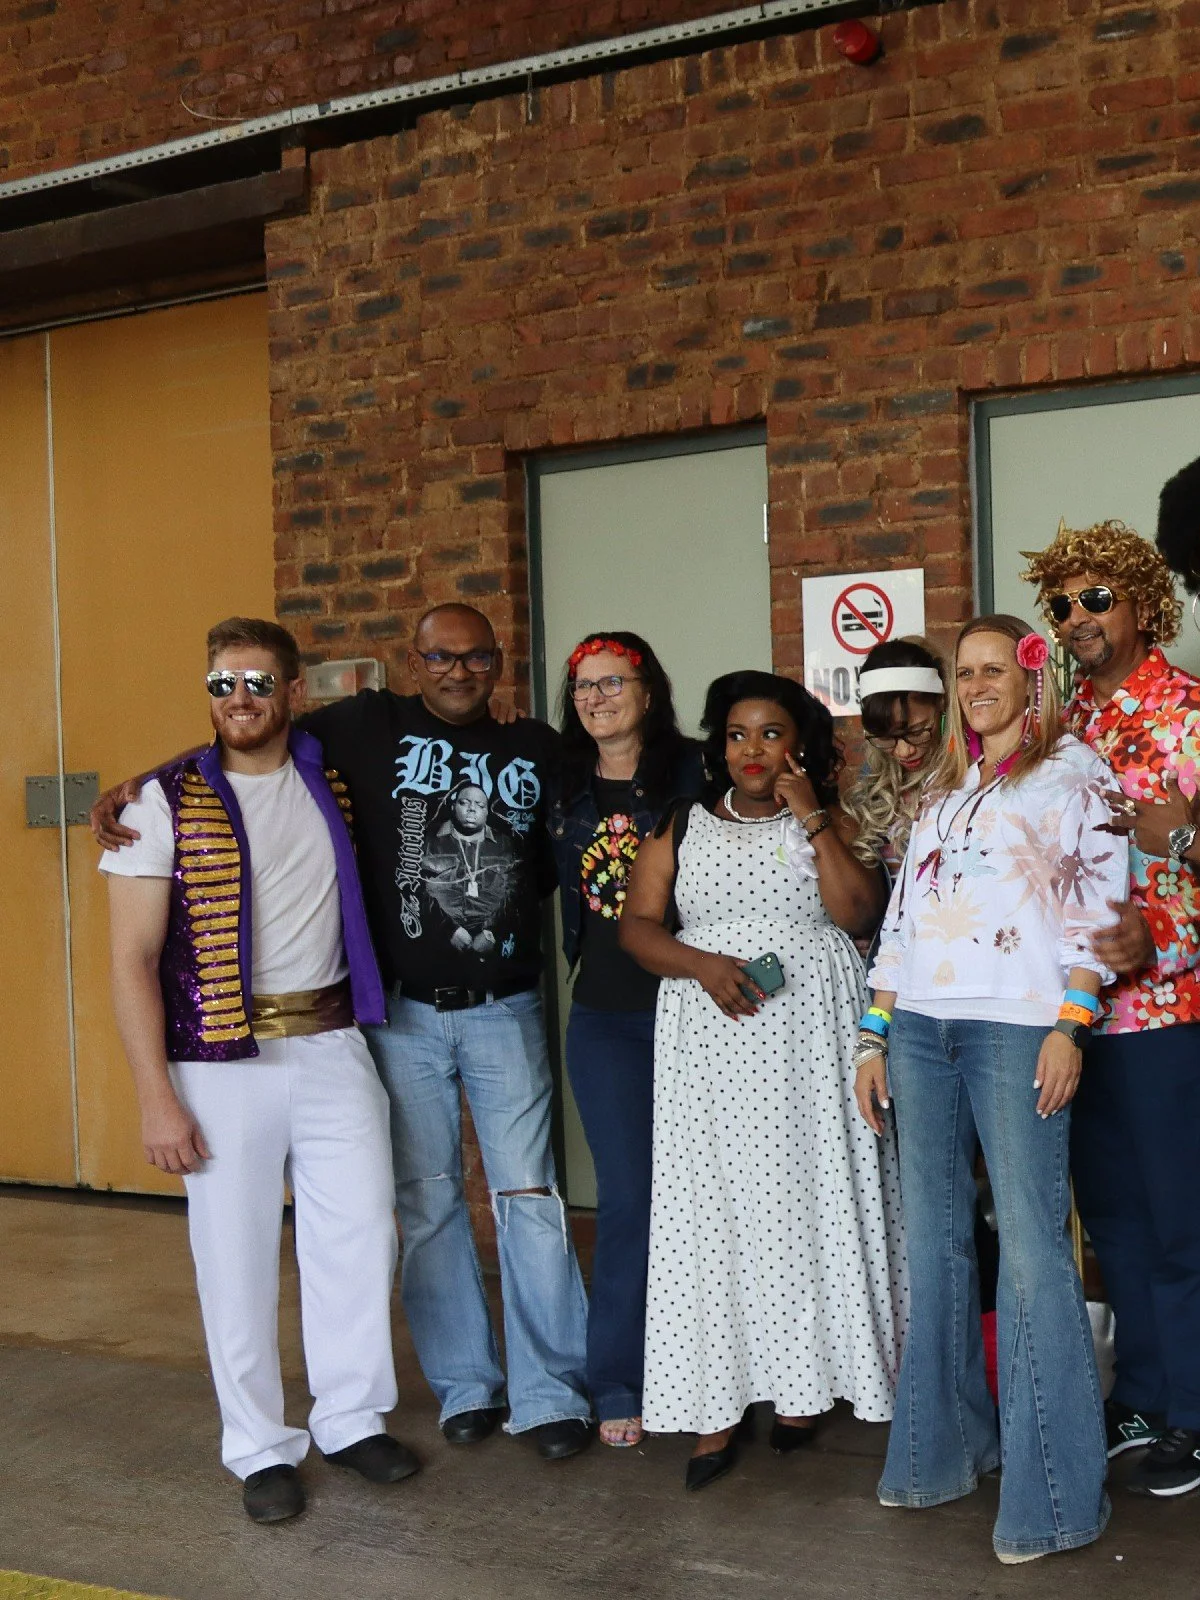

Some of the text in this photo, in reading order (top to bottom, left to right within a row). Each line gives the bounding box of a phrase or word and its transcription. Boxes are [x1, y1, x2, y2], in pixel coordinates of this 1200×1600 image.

[813, 666, 850, 706] NO
[391, 734, 541, 809] BIG
[395, 796, 428, 939] The Notorious
